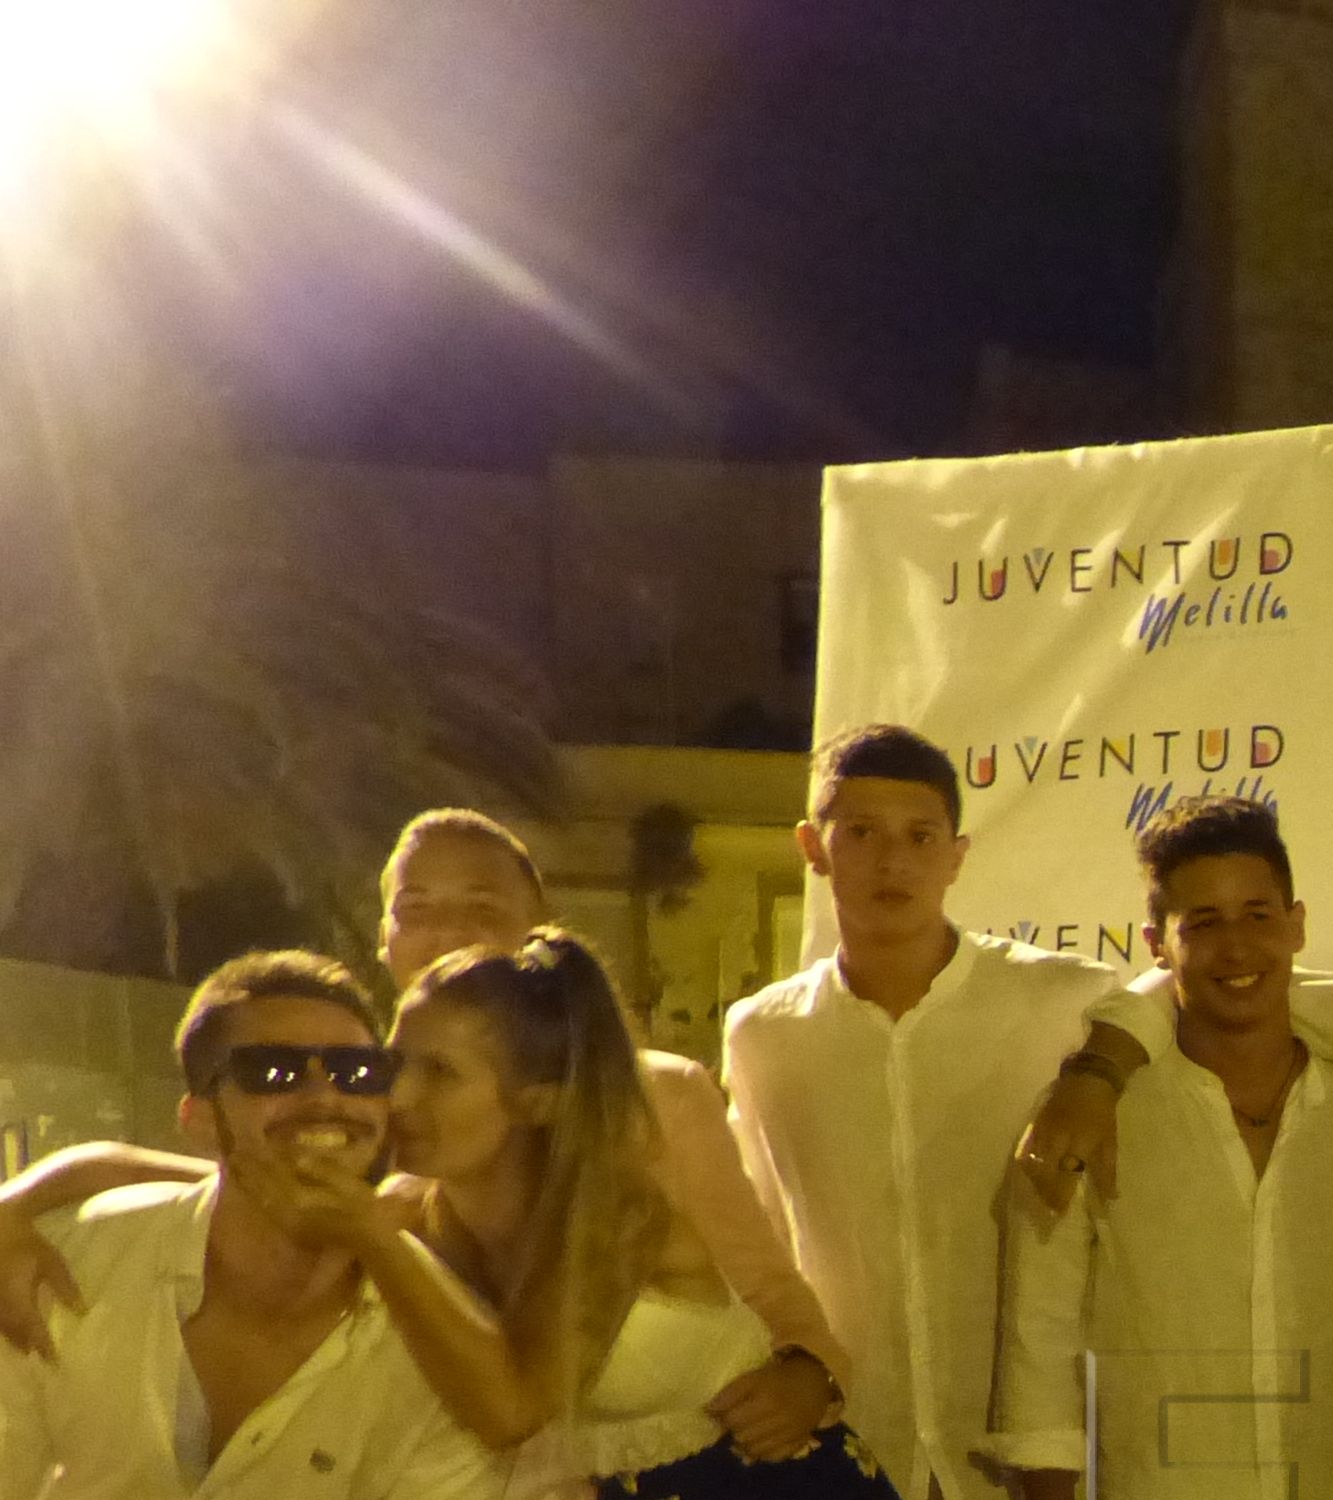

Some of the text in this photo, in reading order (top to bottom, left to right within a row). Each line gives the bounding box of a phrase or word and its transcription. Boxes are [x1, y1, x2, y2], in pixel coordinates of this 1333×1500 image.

[943, 532, 1294, 605] JUVENTUD
[1139, 581, 1287, 654] Melilla
[966, 725, 1284, 788] UVENTUD
